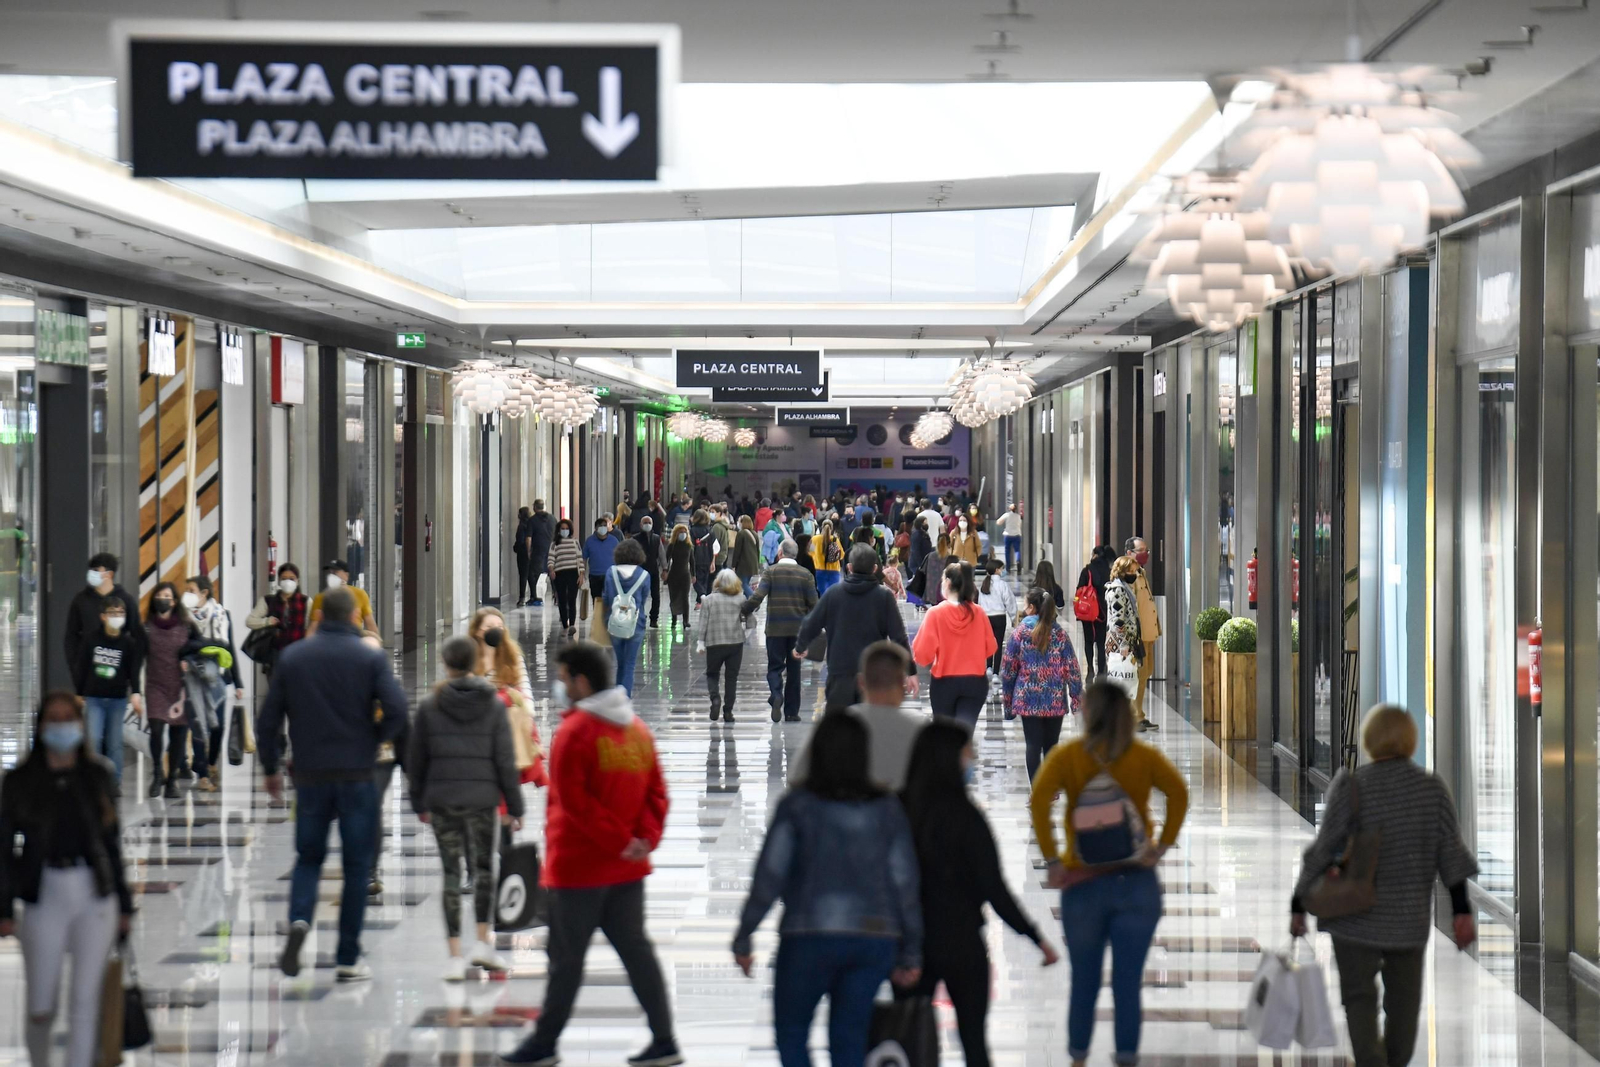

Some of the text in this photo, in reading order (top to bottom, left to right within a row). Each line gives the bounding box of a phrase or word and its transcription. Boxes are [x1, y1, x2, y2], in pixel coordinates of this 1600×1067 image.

[168, 61, 579, 107] PLAZA CENTRAL
[197, 119, 548, 159] PLAZA ALHAMBRA
[693, 363, 802, 374] PLAZA CENTRAL
[933, 476, 969, 488] yoigo
[93, 646, 123, 658] GAME
[93, 654, 121, 667] MODE
[1107, 670, 1134, 679] KIABI
